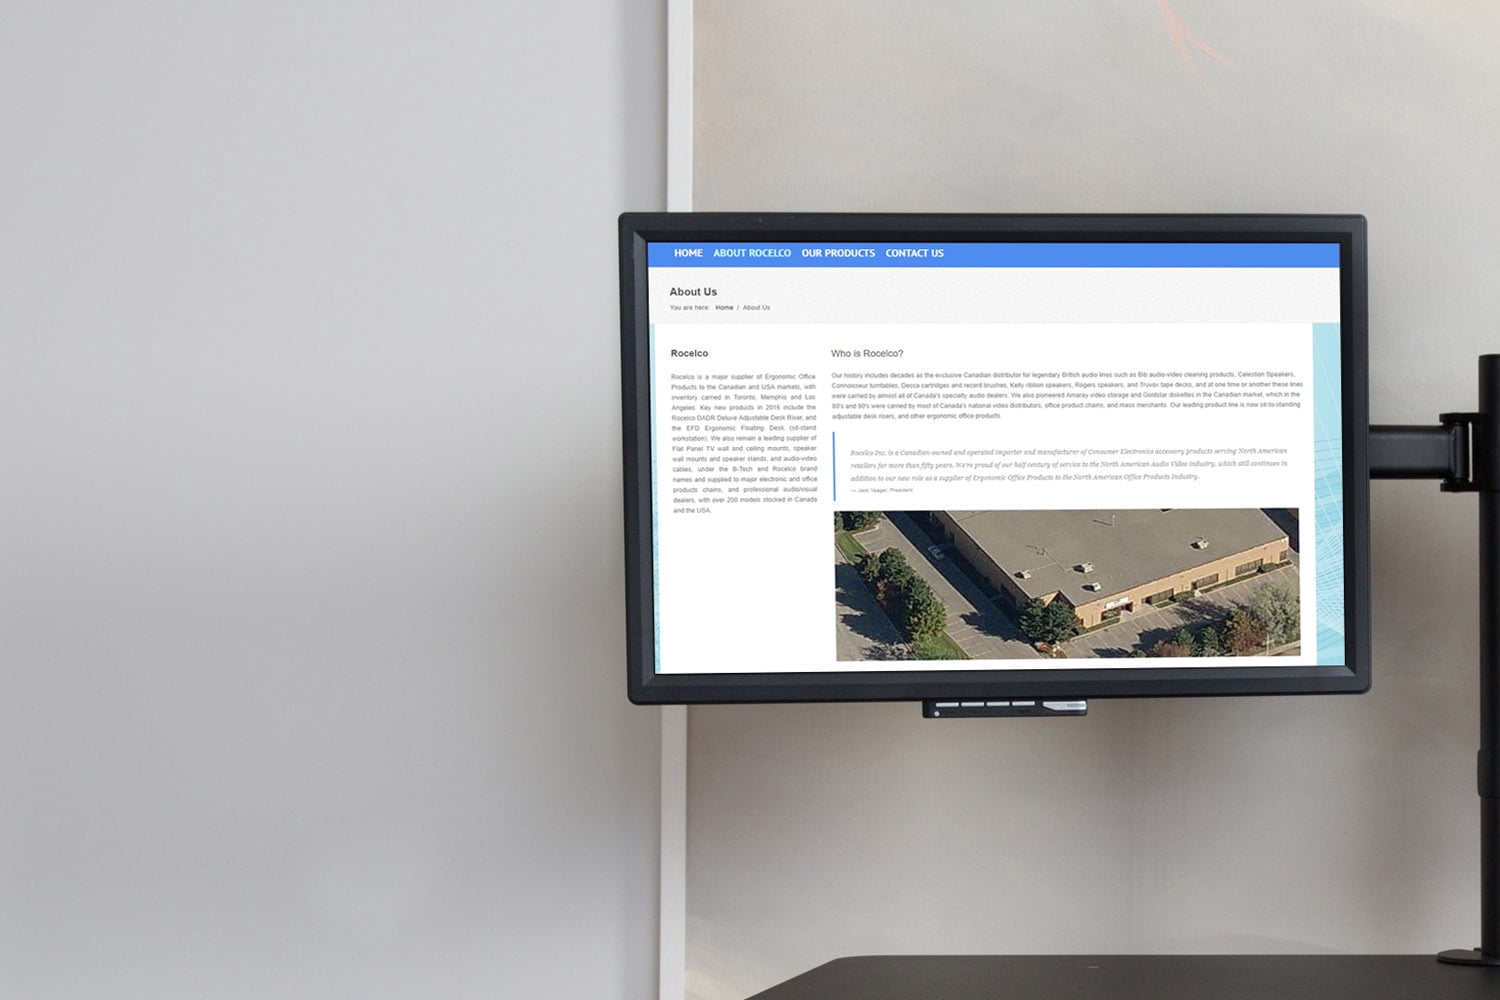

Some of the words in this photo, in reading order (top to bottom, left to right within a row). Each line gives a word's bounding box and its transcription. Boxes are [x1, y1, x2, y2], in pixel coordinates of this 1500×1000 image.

[674, 249, 703, 257] HOME
[713, 249, 747, 257] ABOUT
[748, 249, 791, 257] ROCELCO
[801, 249, 822, 257] OUR
[824, 249, 875, 257] PRODUCTS
[885, 249, 929, 257] CONTACT
[931, 249, 944, 257] US
[669, 287, 701, 296] About
[703, 287, 717, 296] Us
[670, 349, 708, 357] Rocelco
[830, 349, 851, 357] Who
[853, 349, 861, 357] is
[862, 349, 903, 357] Rocelco?
